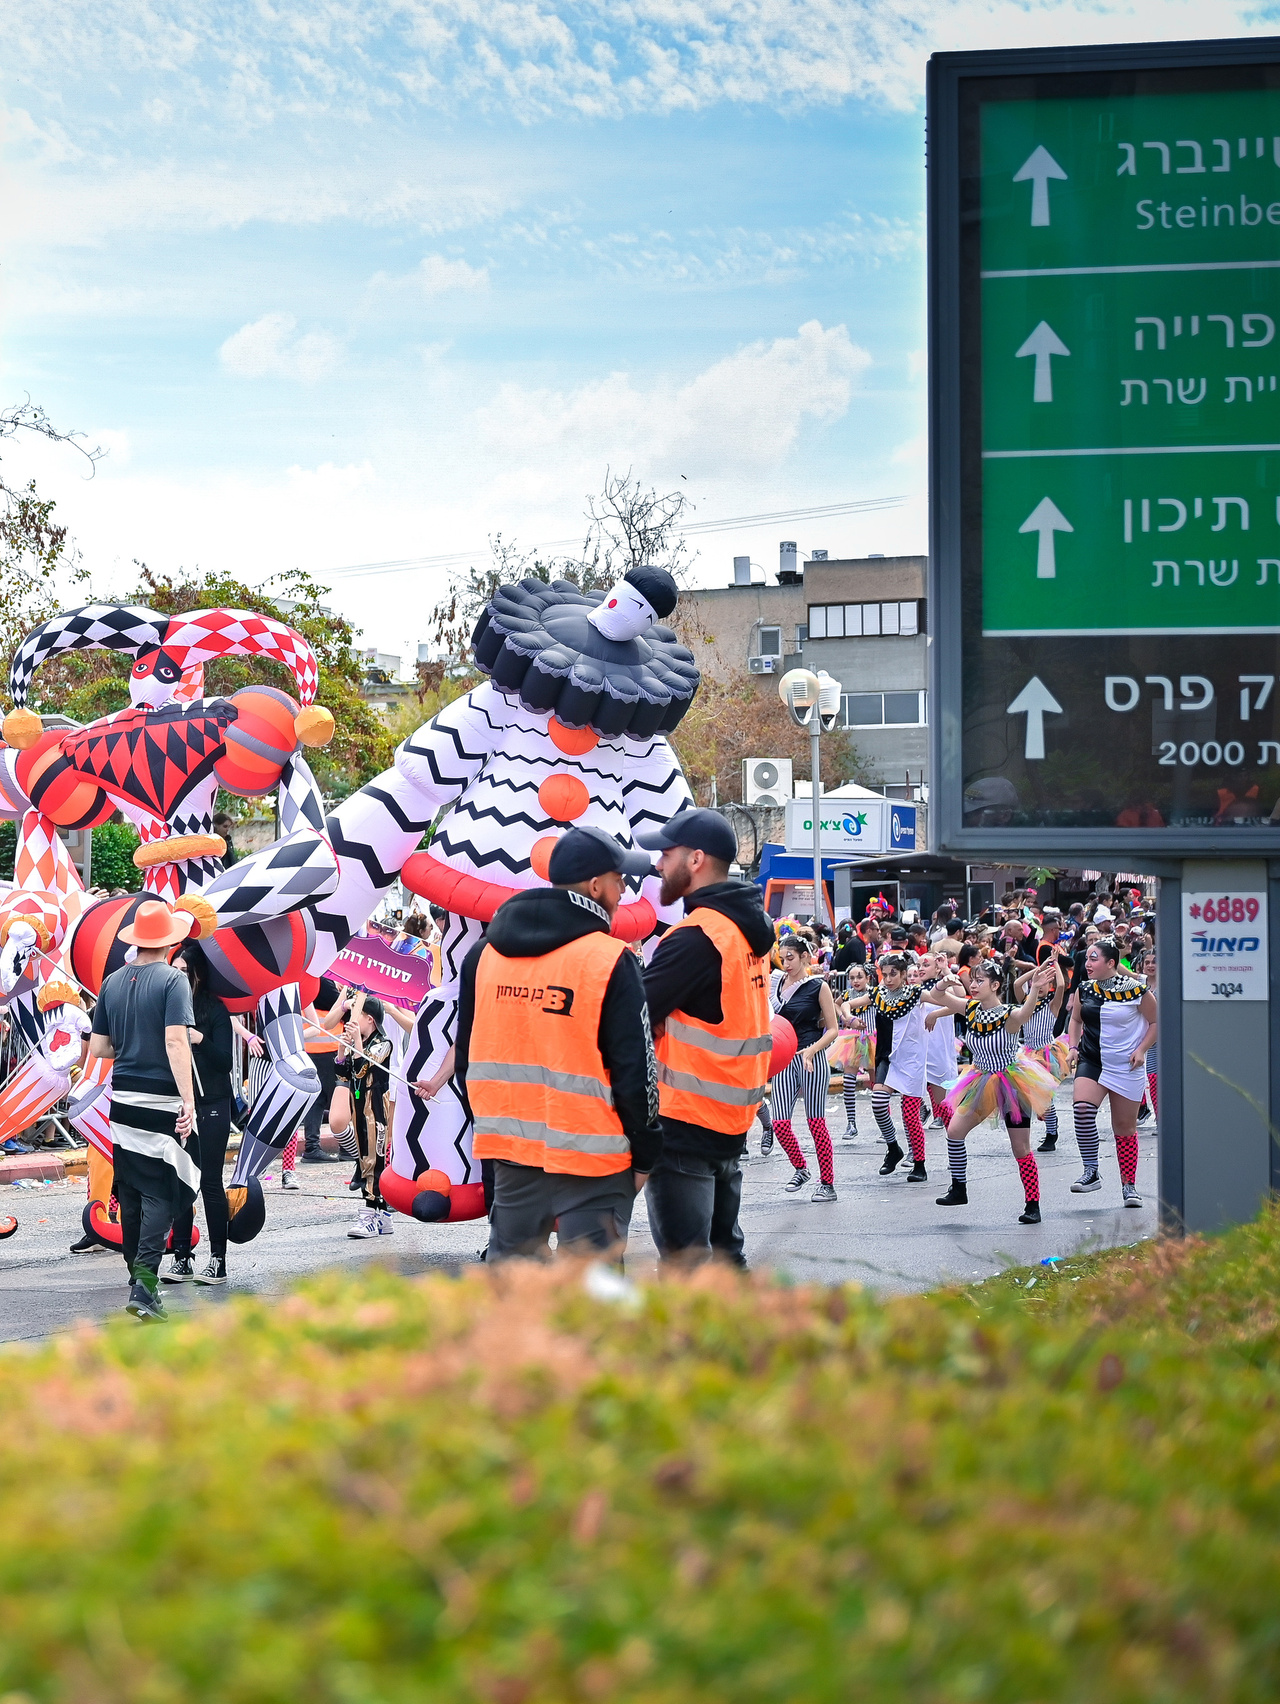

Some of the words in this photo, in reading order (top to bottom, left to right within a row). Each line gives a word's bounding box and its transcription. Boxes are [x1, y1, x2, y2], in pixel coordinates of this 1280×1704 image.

[1117, 137, 1280, 177] יינברג
[1136, 194, 1280, 230] Steinbe
[1120, 377, 1207, 406] שרת
[1124, 496, 1250, 544] תיכון
[1151, 559, 1239, 588] שרת
[1104, 675, 1215, 712] פרס
[1238, 675, 1280, 721] ק
[1158, 741, 1246, 766] 2000
[803, 819, 841, 831] צ'אס
[1190, 936, 1260, 952] מאור
[366, 957, 413, 983] סטודיו
[496, 985, 529, 999] בטחון
[531, 988, 544, 1002] בן
